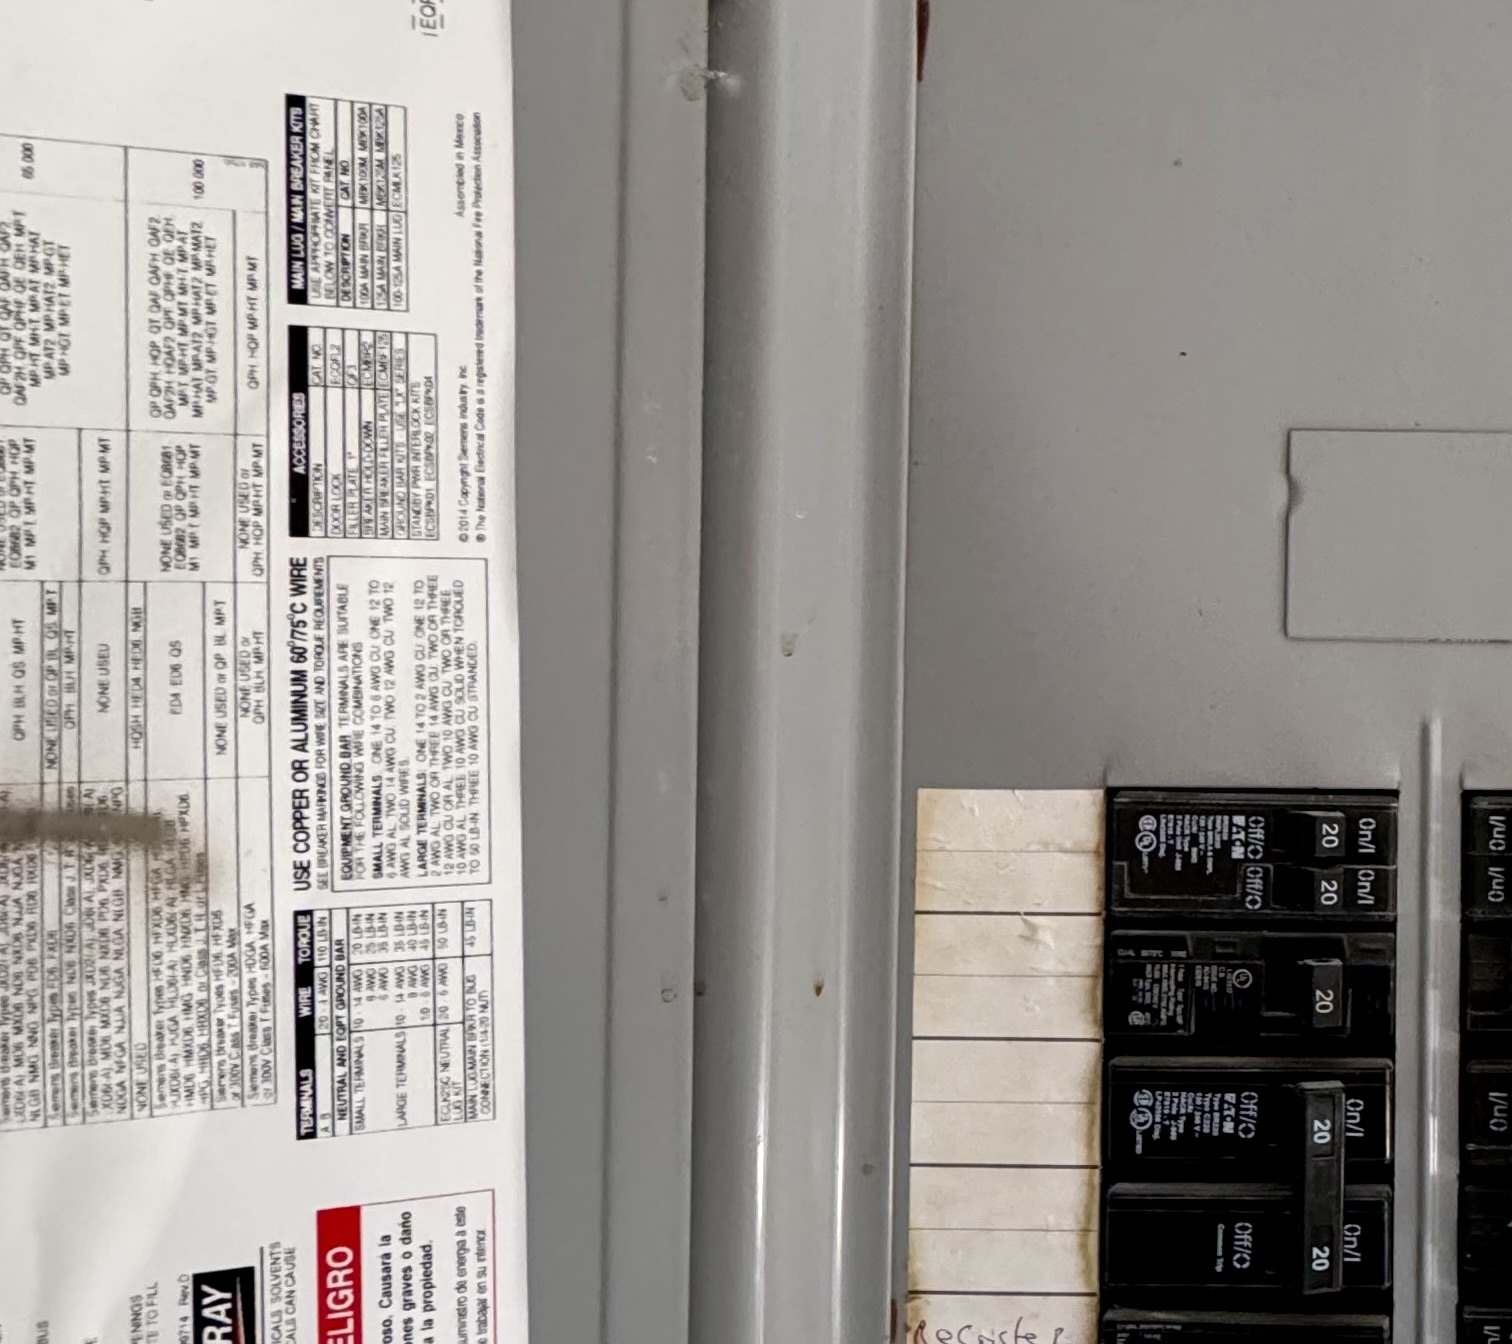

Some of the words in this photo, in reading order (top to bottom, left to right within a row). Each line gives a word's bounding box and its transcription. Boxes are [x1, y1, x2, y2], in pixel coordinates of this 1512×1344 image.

[292, 261, 305, 289] MAIN
[292, 392, 306, 474] ACCESSORIES
[288, 556, 307, 597] WIRE
[290, 669, 309, 753] ALUMINUM
[292, 759, 310, 783] OR
[292, 788, 310, 853] COPPER
[1321, 822, 1340, 849] 20
[293, 860, 311, 891] USE
[1320, 879, 1339, 907] 20
[1315, 988, 1334, 1015] 20
[1313, 1118, 1331, 1144] 20
[377, 1234, 392, 1247] la
[397, 1211, 413, 1245] daño
[401, 1251, 413, 1260] o
[1312, 1246, 1330, 1272] 20
[400, 1266, 416, 1311] graves
[419, 1240, 437, 1312] propiedad.
[420, 1318, 434, 1331] la
[422, 1336, 434, 1344] a
